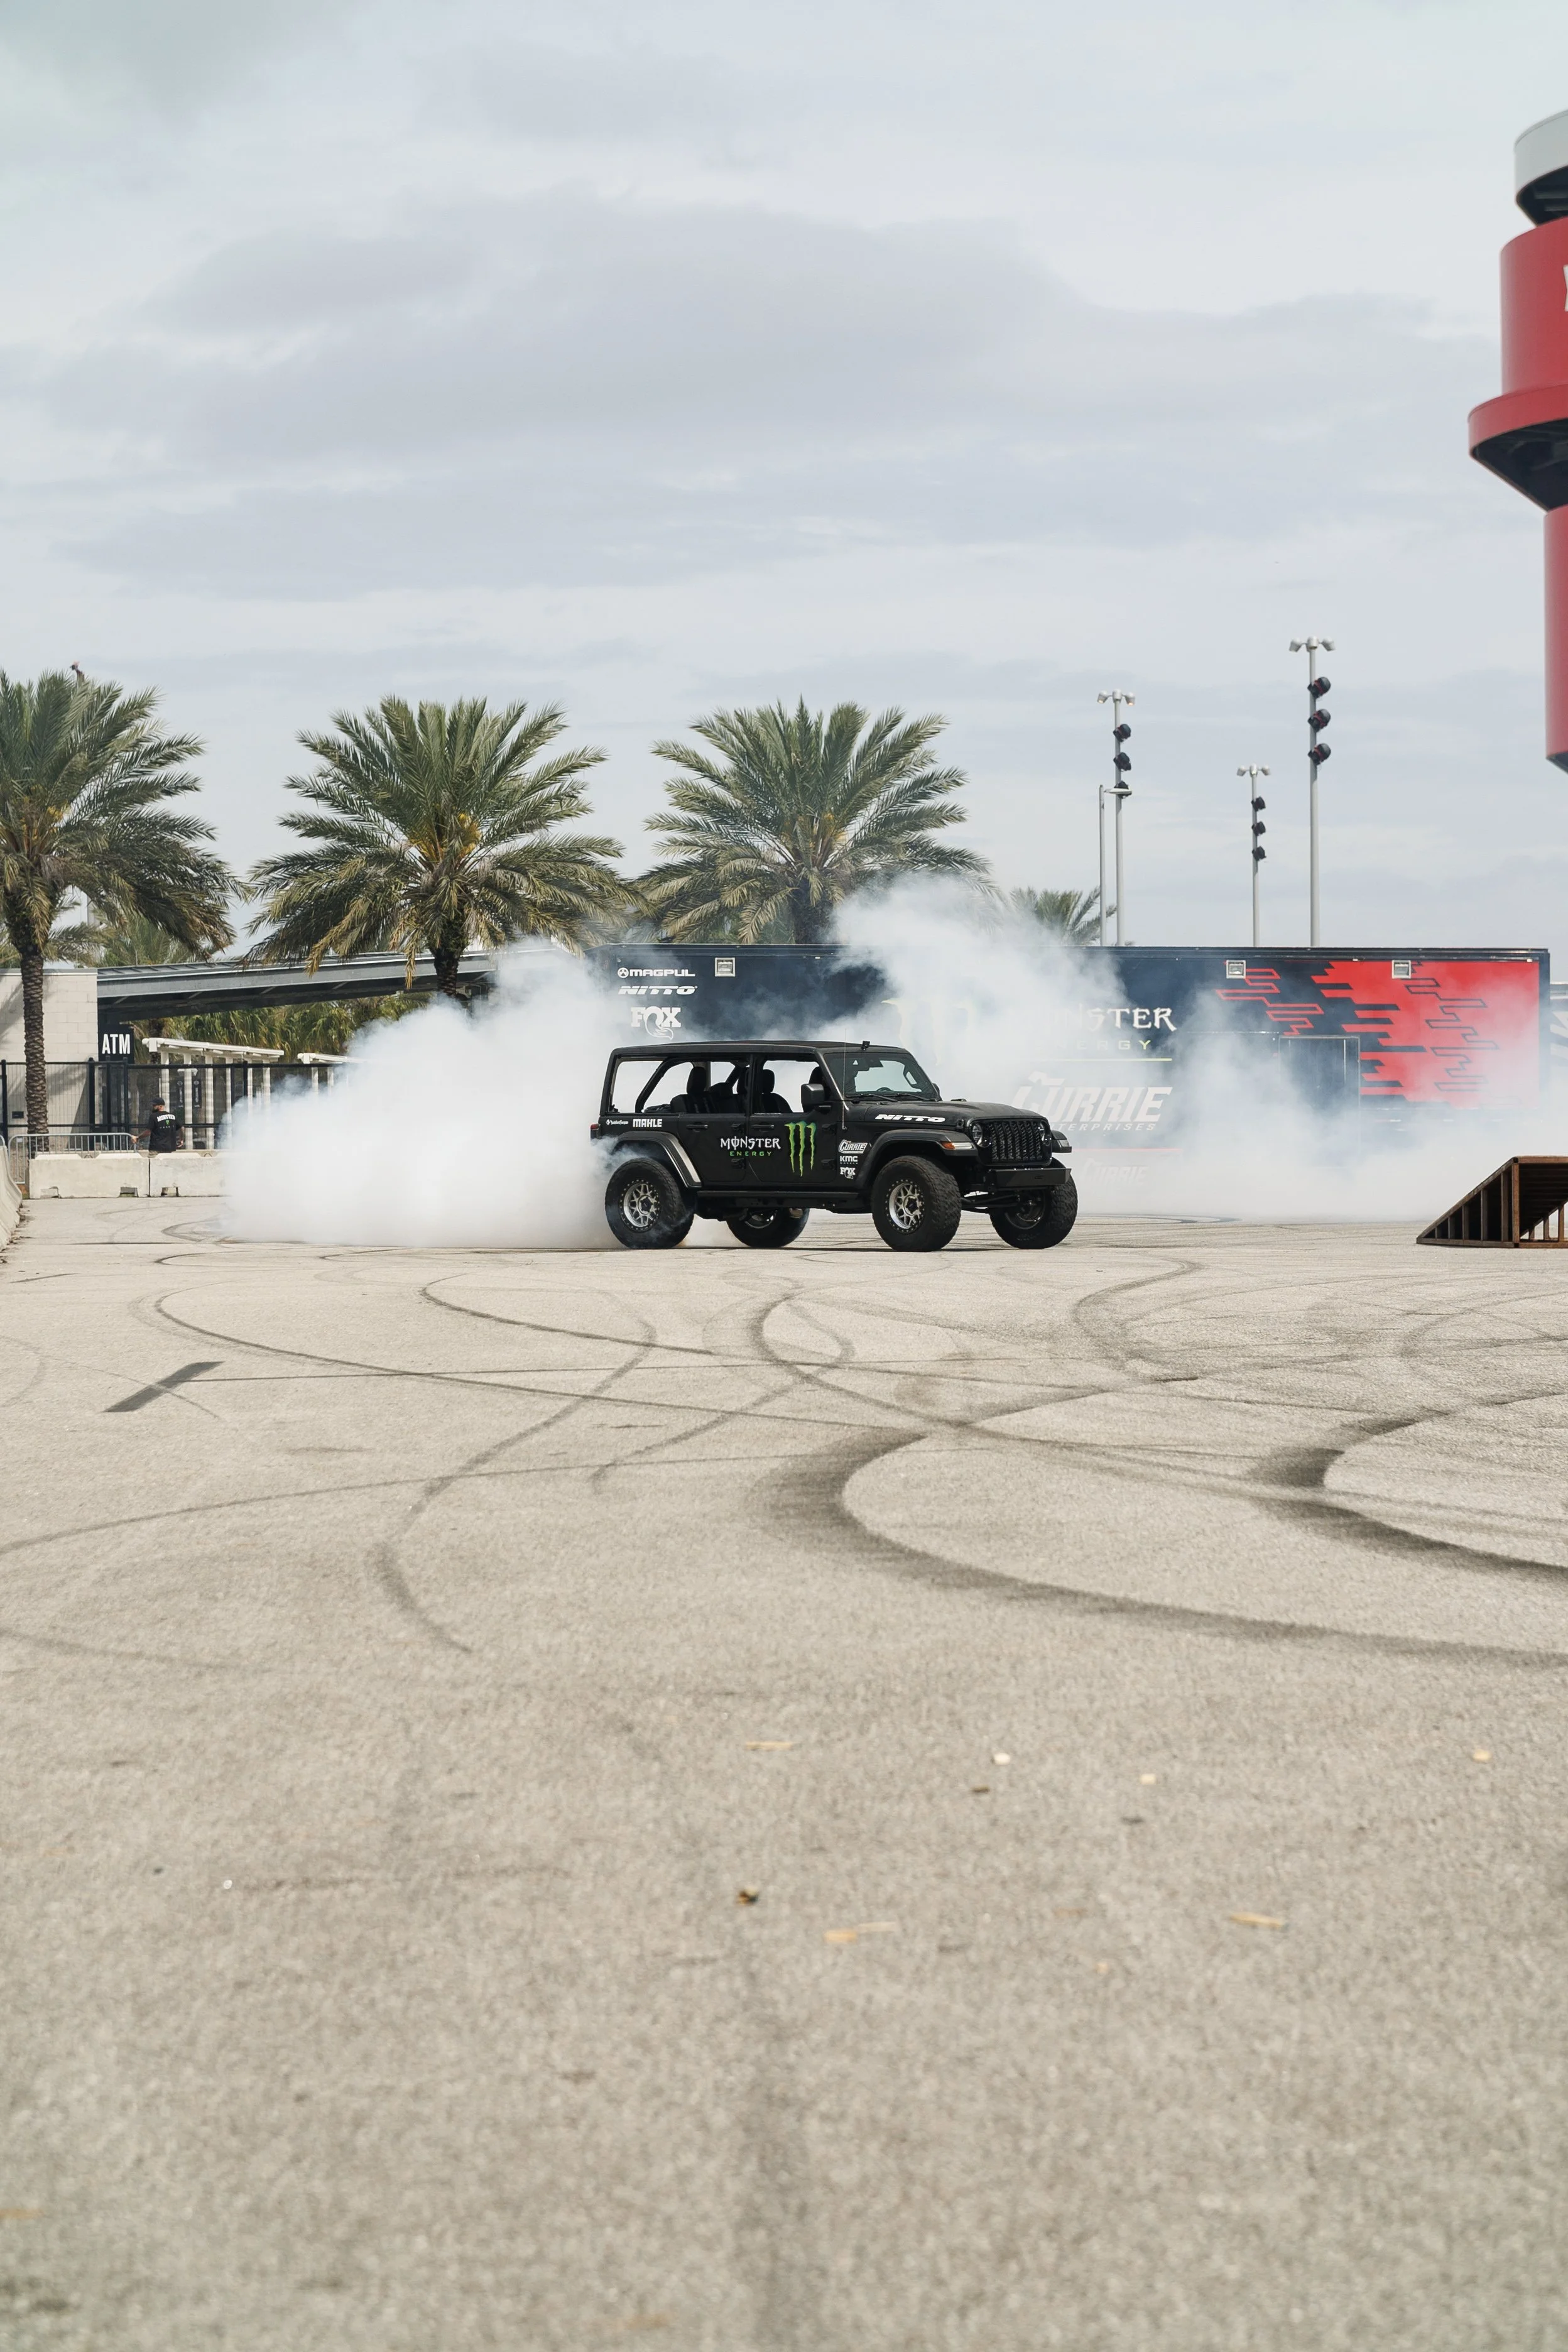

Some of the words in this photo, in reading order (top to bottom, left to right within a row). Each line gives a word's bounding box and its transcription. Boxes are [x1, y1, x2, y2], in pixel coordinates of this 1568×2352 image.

[629, 969, 695, 977] MAGPUL
[618, 985, 695, 995] NITTO
[631, 1006, 682, 1040] FOX
[102, 1033, 131, 1054] ATM
[1011, 1070, 1173, 1123] CURRIE
[633, 1118, 663, 1128] MAHLE
[875, 1114, 945, 1123] NITTO
[720, 1136, 781, 1150] MONSTER
[839, 1140, 867, 1151] CURRIE
[840, 1167, 856, 1179] FOX
